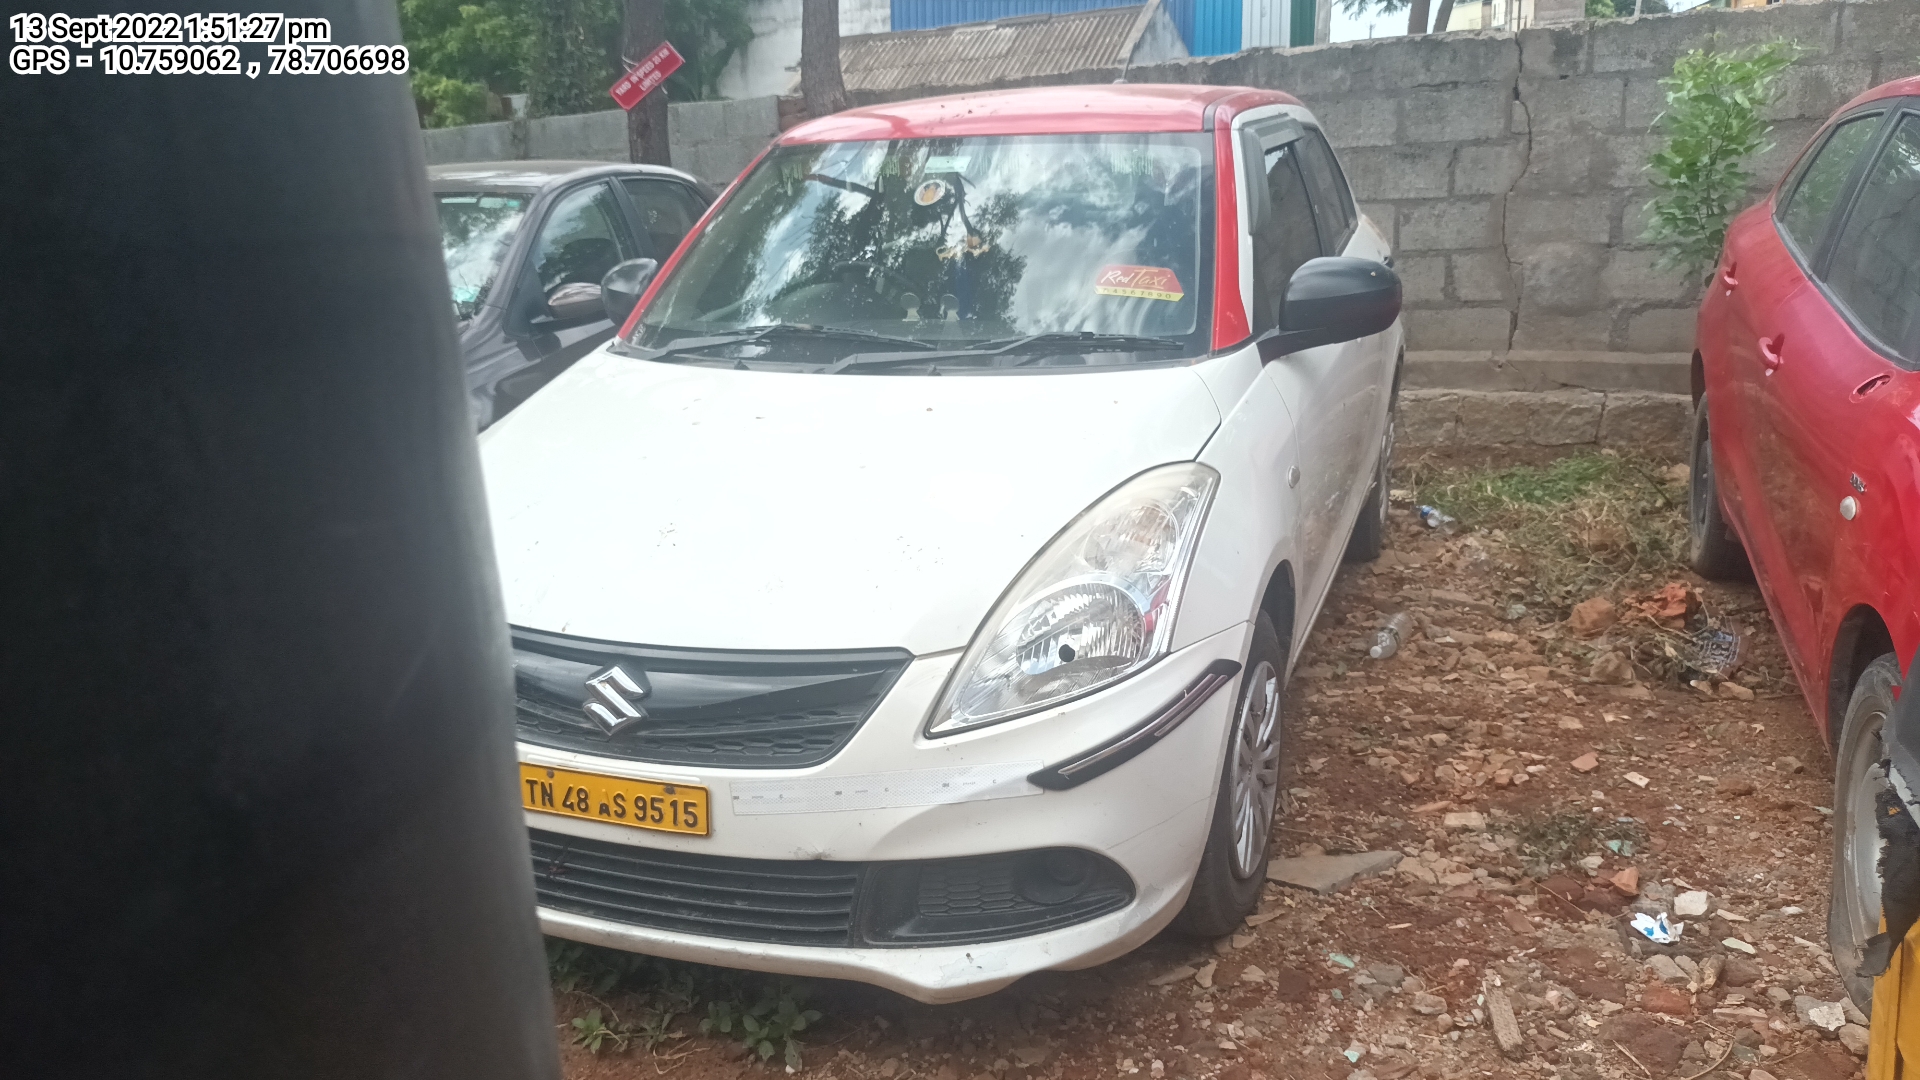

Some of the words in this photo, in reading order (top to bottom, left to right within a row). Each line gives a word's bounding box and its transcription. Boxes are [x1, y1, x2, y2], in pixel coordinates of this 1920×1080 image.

[1100, 270, 1135, 285] Red
[1130, 268, 1171, 288] Taxi
[525, 778, 555, 808] TN
[561, 784, 590, 813] 48
[598, 788, 628, 819] AS
[633, 794, 699, 829] 9515
